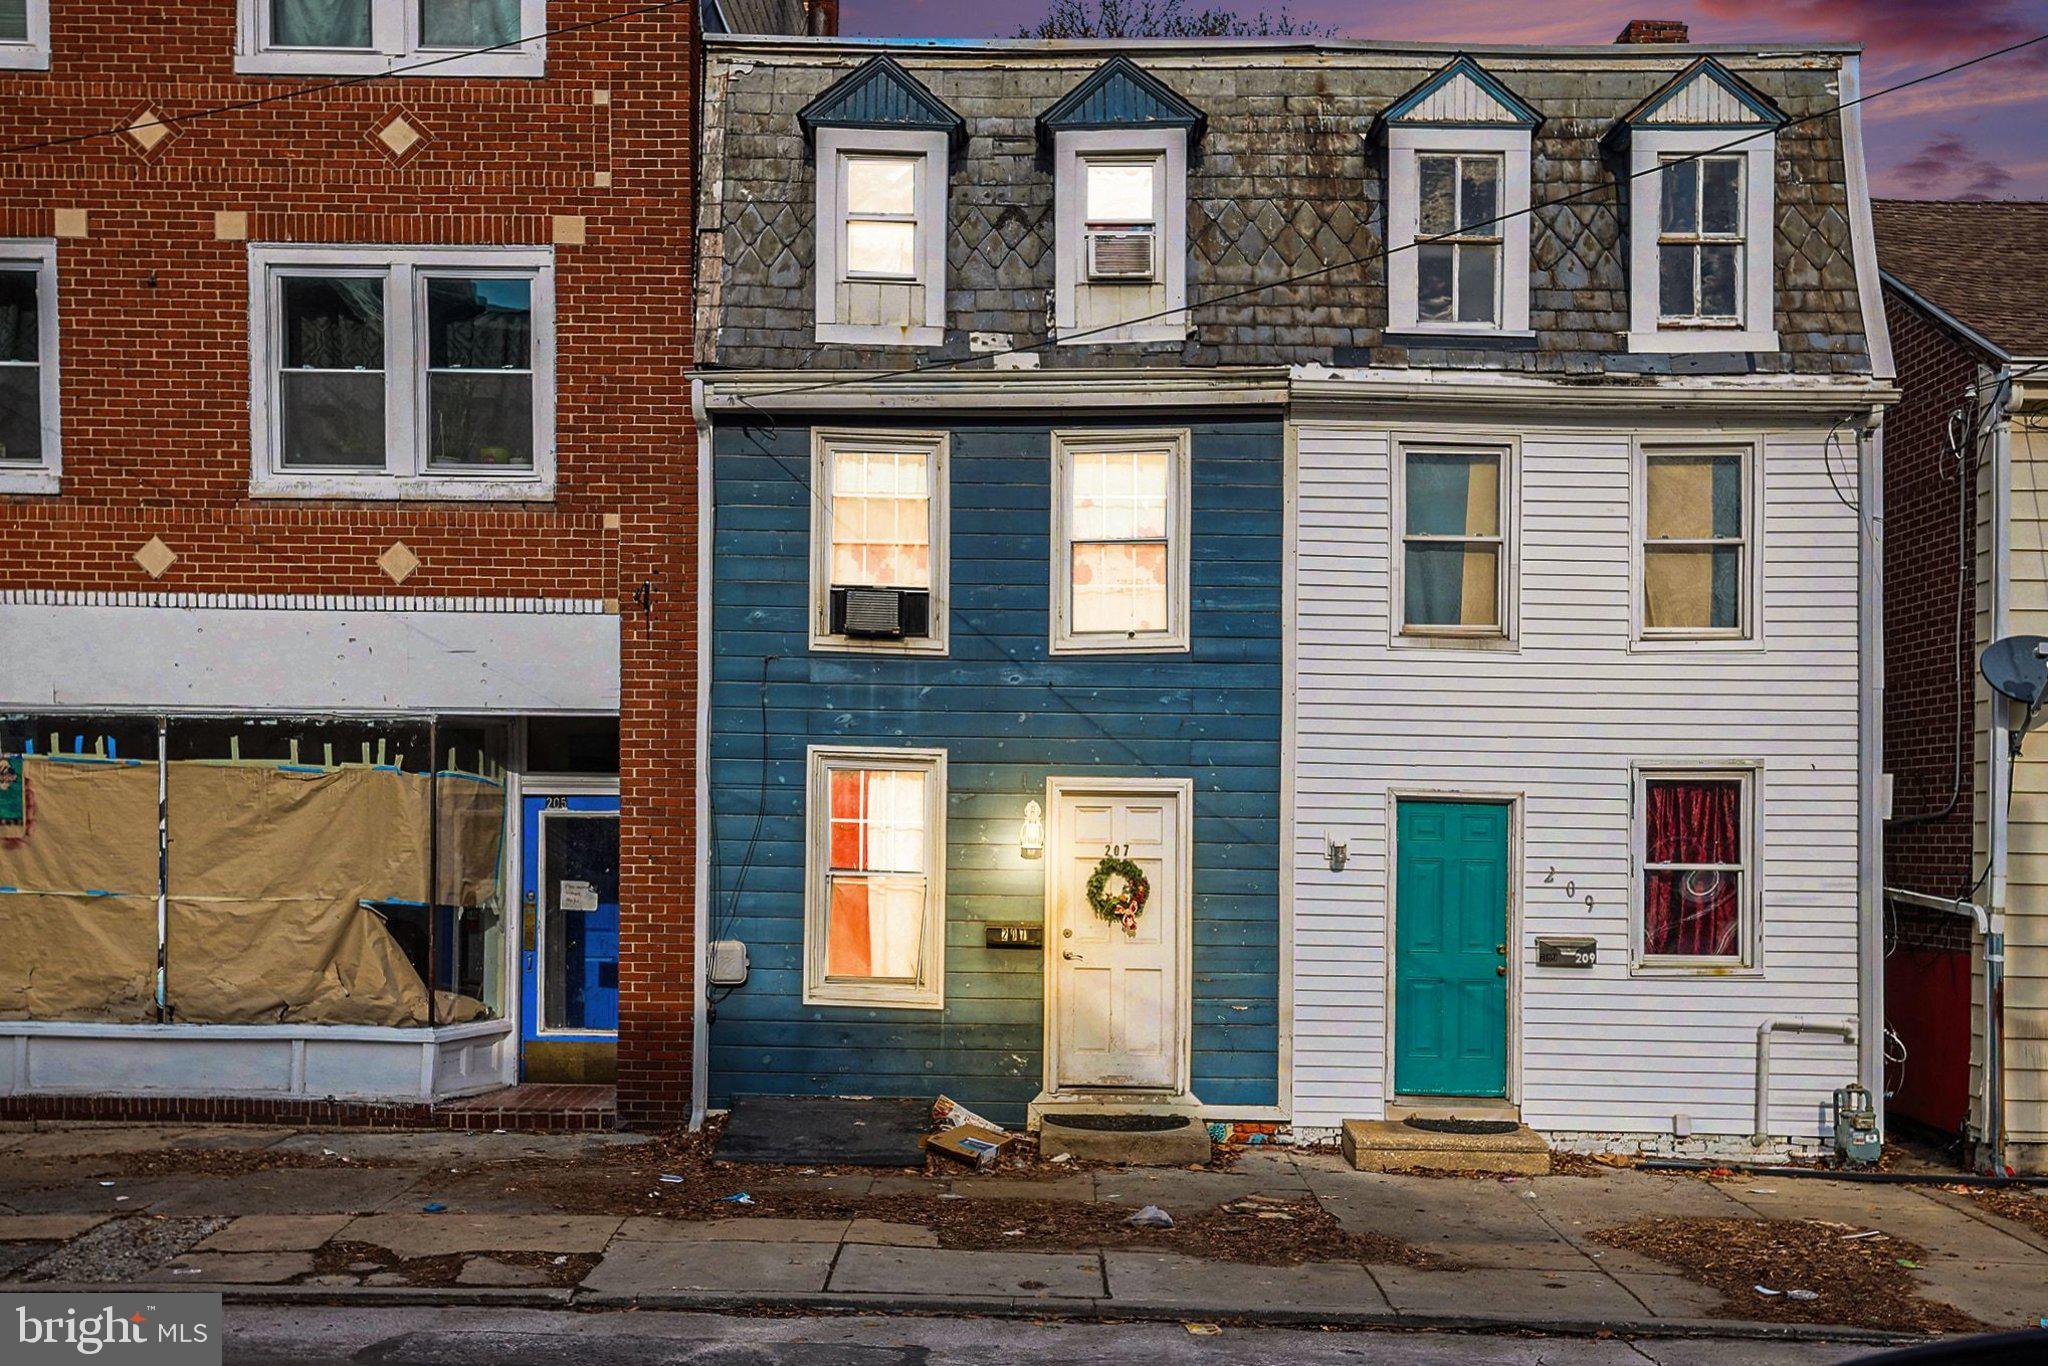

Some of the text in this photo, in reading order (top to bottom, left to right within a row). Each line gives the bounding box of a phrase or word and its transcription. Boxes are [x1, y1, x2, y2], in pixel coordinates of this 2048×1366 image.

[546, 796, 568, 810] 205
[1104, 844, 1130, 857] 207
[1575, 952, 1596, 964] 209
